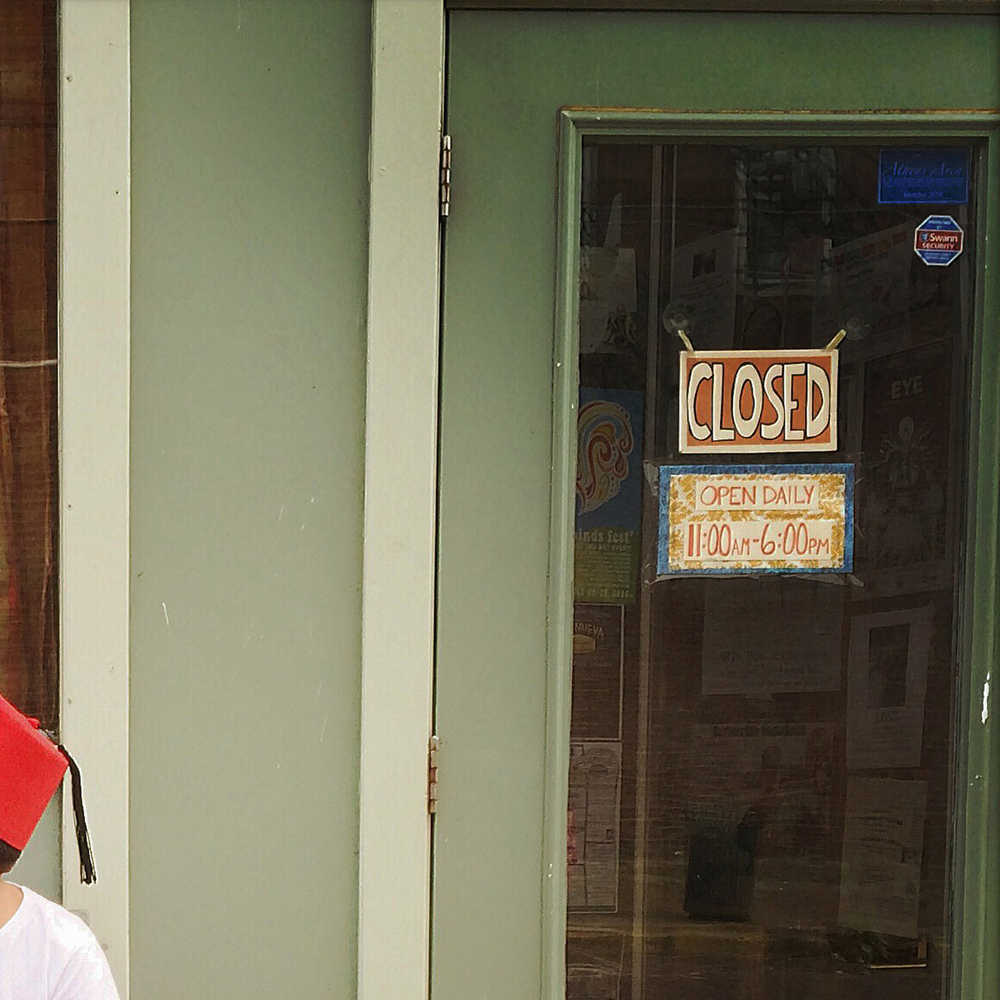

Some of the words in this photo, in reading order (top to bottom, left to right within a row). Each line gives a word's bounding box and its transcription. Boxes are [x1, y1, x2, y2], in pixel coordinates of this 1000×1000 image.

[922, 242, 955, 250] SECURITY
[891, 375, 923, 400] EYE
[687, 362, 832, 441] CLOSED
[700, 485, 757, 506] OPEN
[763, 485, 815, 506] DAILY
